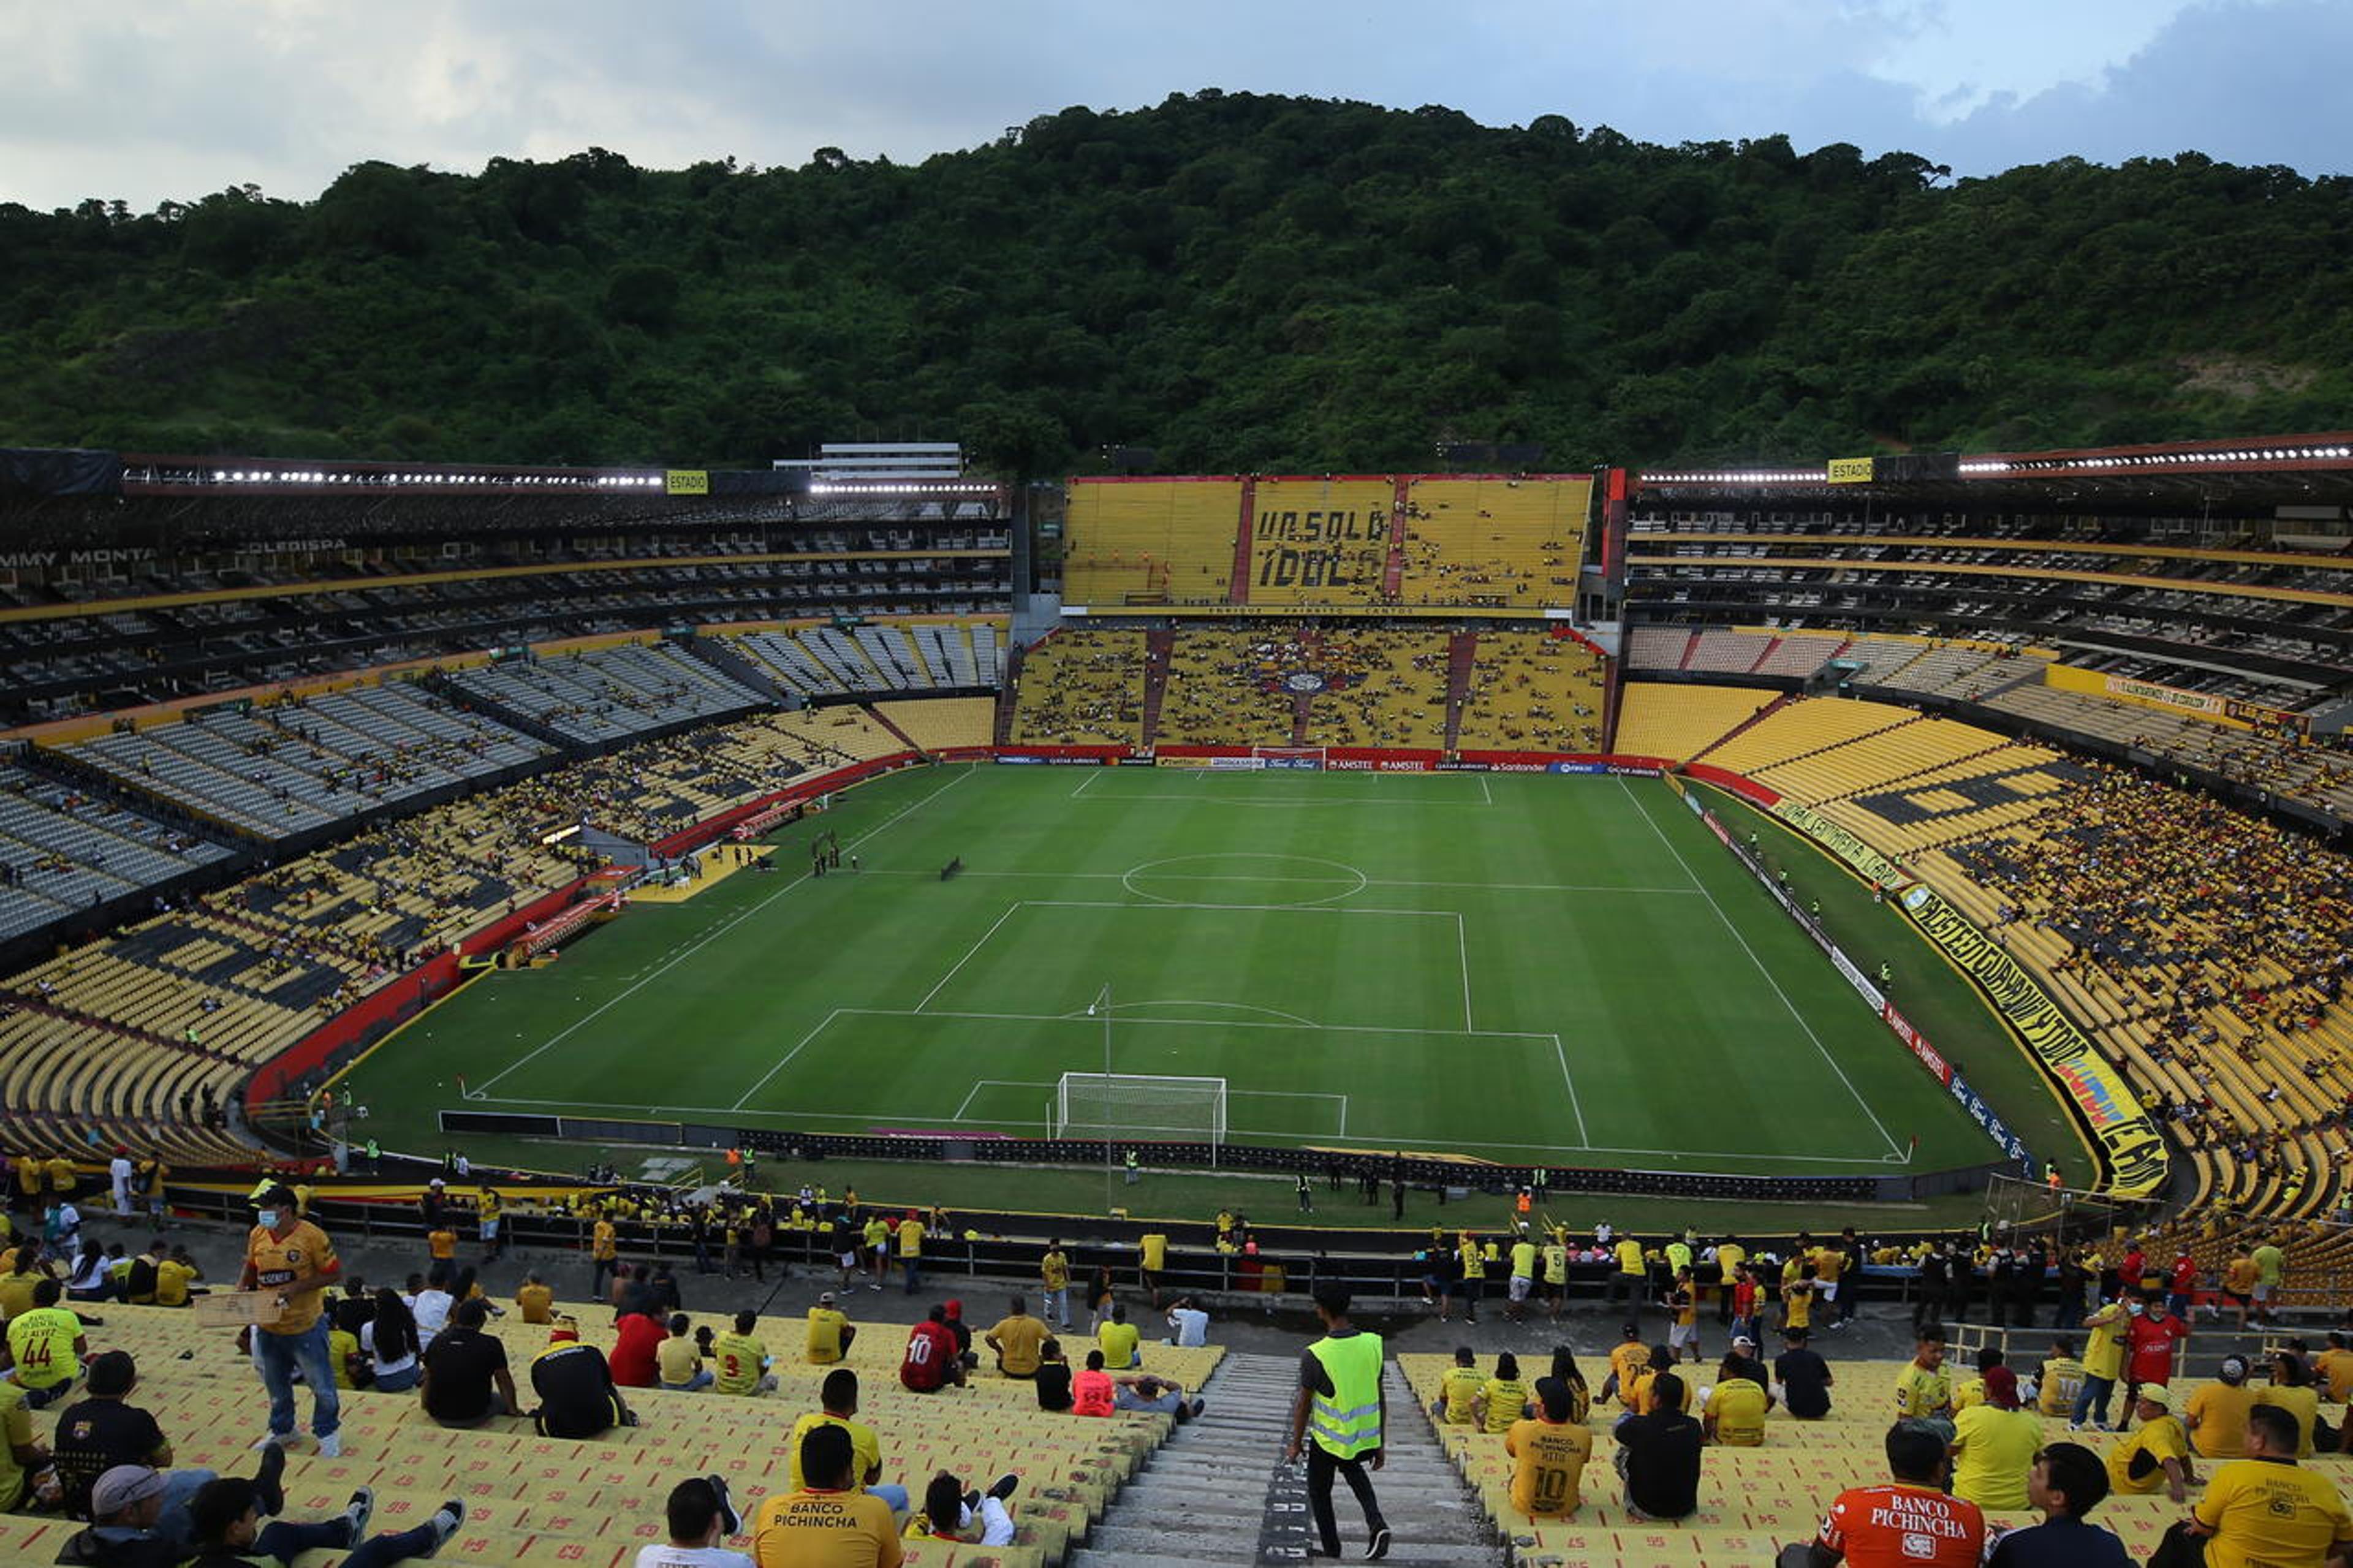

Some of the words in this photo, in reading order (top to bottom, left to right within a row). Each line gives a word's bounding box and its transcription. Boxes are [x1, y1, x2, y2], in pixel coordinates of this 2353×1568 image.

[671, 475, 704, 488] ESTADIO
[1338, 760, 1373, 769] AMSTEL
[1389, 761, 1425, 770] AMSTEL
[1499, 763, 1547, 772] Santander
[23, 1338, 51, 1368] 44
[909, 1338, 931, 1365] 10
[725, 1354, 738, 1377] 3
[1534, 1465, 1567, 1499] 10
[790, 1502, 844, 1514] BANCO
[1892, 1494, 1949, 1519] BANCO
[773, 1514, 858, 1528] PICHINCHA
[1870, 1507, 1967, 1539] PICHINCHA
